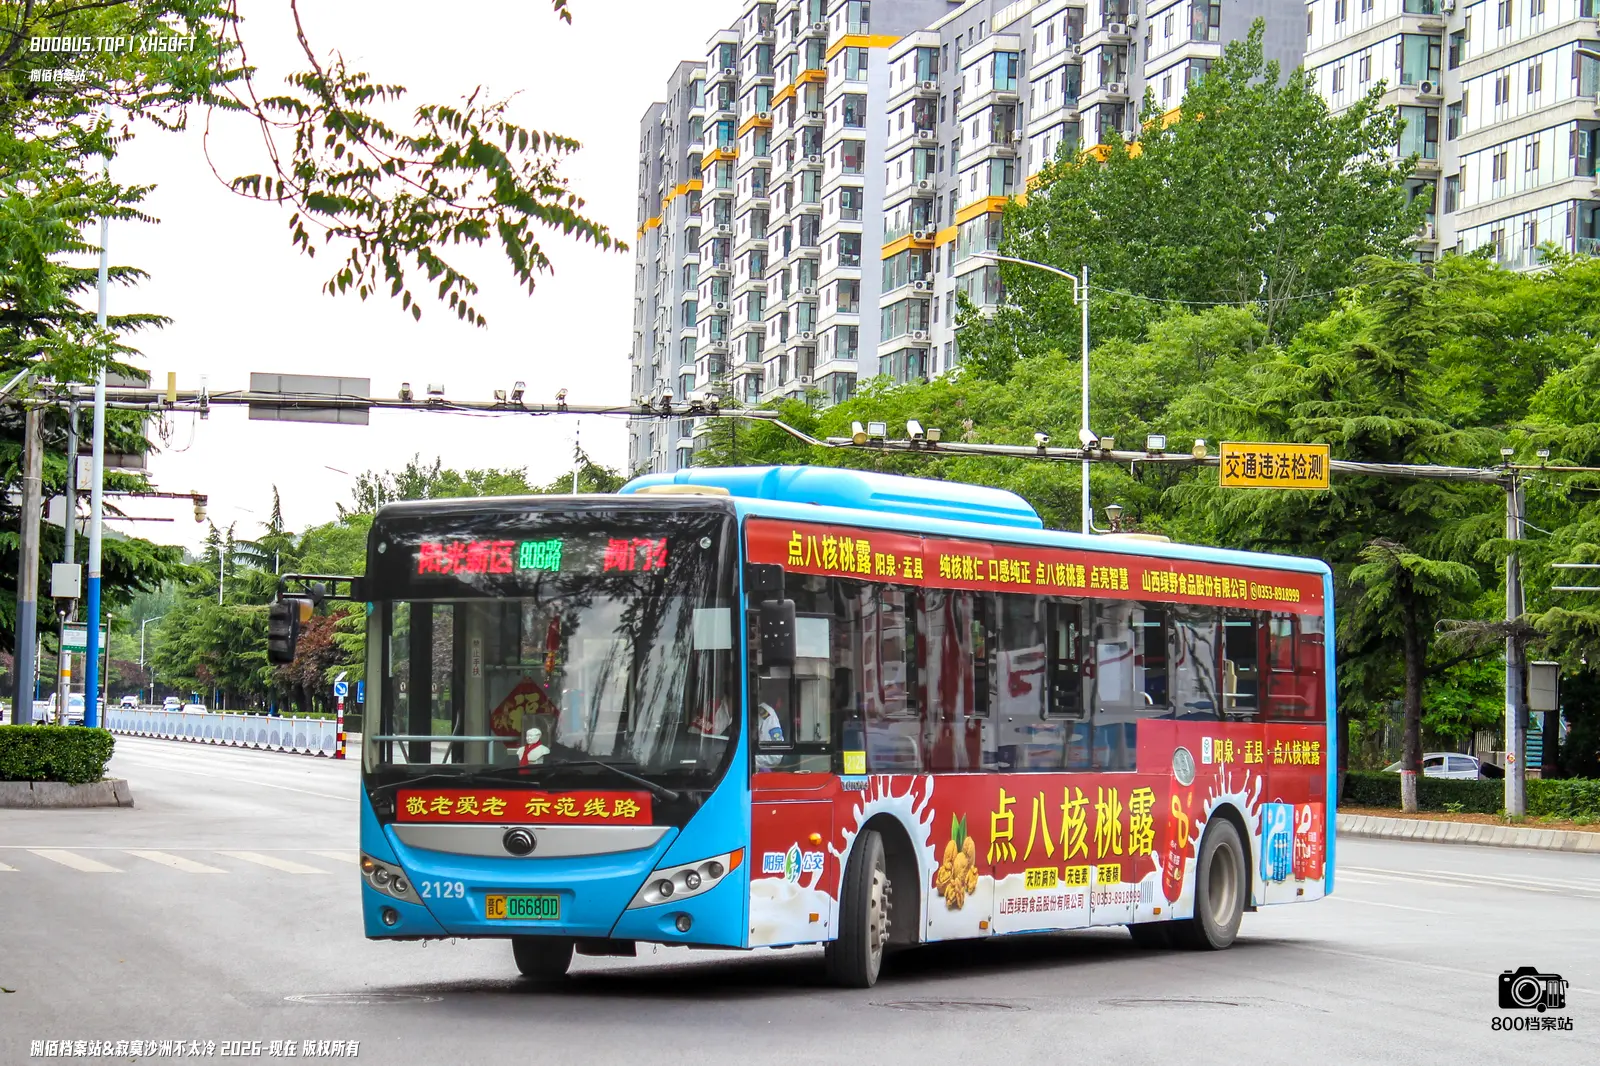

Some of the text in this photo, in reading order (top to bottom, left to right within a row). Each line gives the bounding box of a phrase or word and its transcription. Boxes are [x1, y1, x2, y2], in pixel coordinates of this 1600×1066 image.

[1225, 452, 1323, 480] 交通违法检测
[520, 540, 562, 572] 808路
[788, 530, 871, 574] 点八核桃露
[939, 554, 985, 580] 纯核桃仁
[988, 559, 1031, 584] 口感纯正
[1035, 561, 1087, 588] 点八核桃露
[1090, 565, 1130, 590] 点亮智慧
[1142, 569, 1248, 600] 山西绿野食品股份有限公司
[406, 796, 641, 819] 敬老爱老 示范线路
[986, 786, 1157, 865] 点八核桃露
[765, 855, 784, 871] 阳泉
[803, 854, 823, 870] 公交
[1026, 866, 1119, 887] 无防腐剂 无色素 无香精
[421, 881, 465, 899] 2129
[999, 893, 1084, 915] 山西绿野食品股份有限公司
